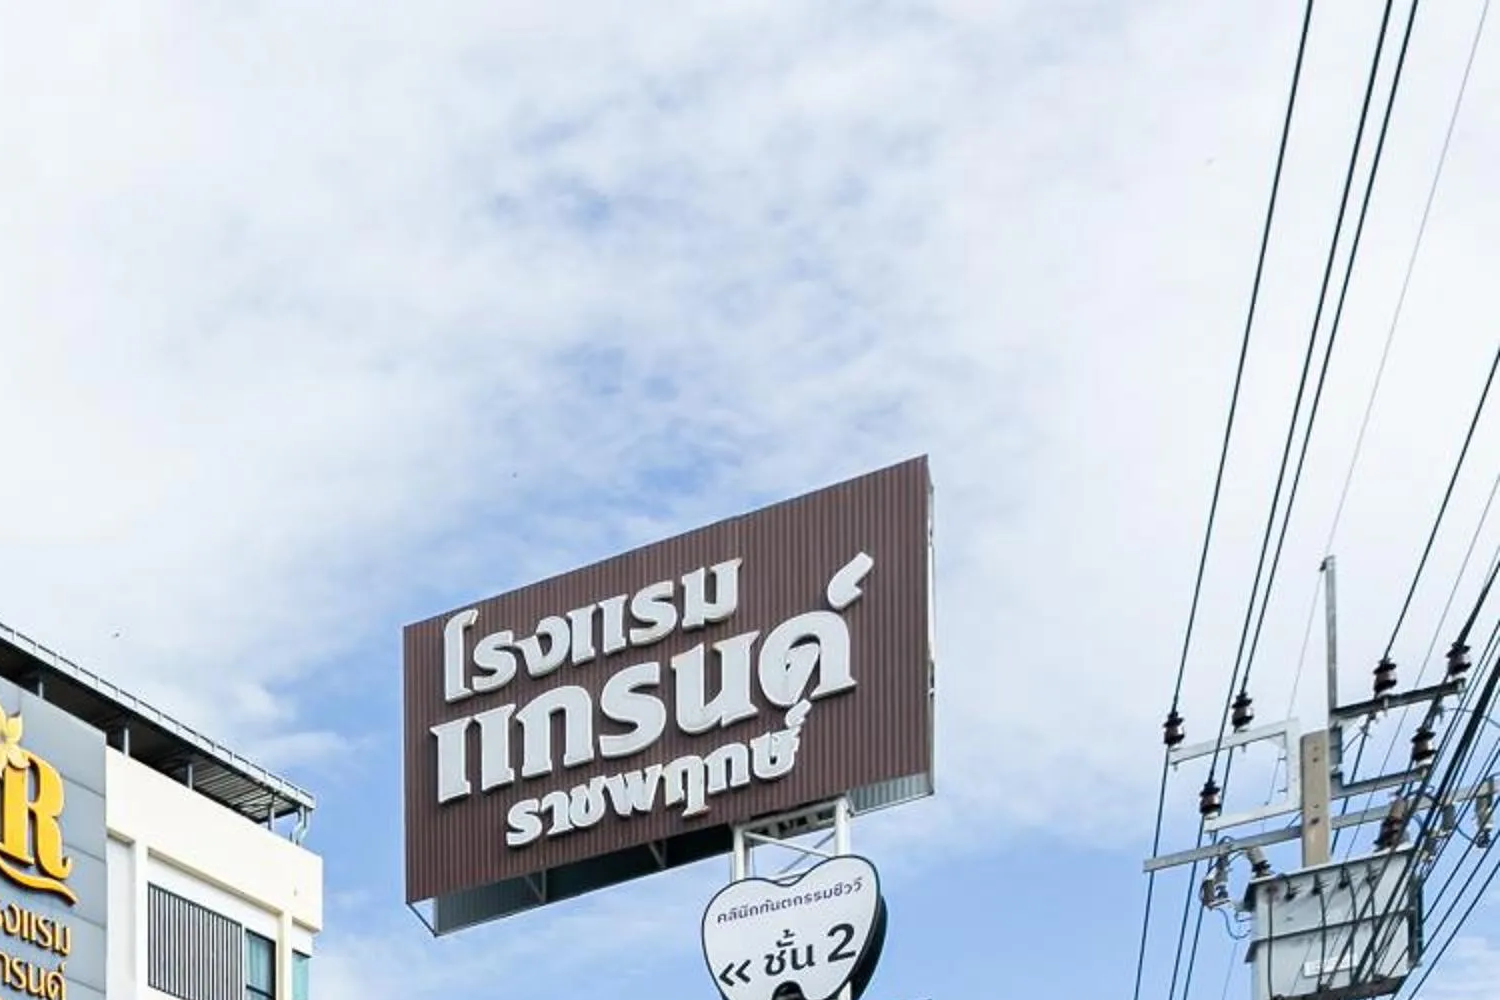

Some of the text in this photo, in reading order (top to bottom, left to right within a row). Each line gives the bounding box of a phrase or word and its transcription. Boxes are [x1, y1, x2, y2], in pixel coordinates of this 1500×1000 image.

[430, 551, 874, 805] แกรนด์
[443, 557, 743, 702] โรงแรม
[0, 751, 71, 881] R
[505, 699, 812, 847] ราชพฤกษ์
[763, 922, 857, 977] ชั้น 2
